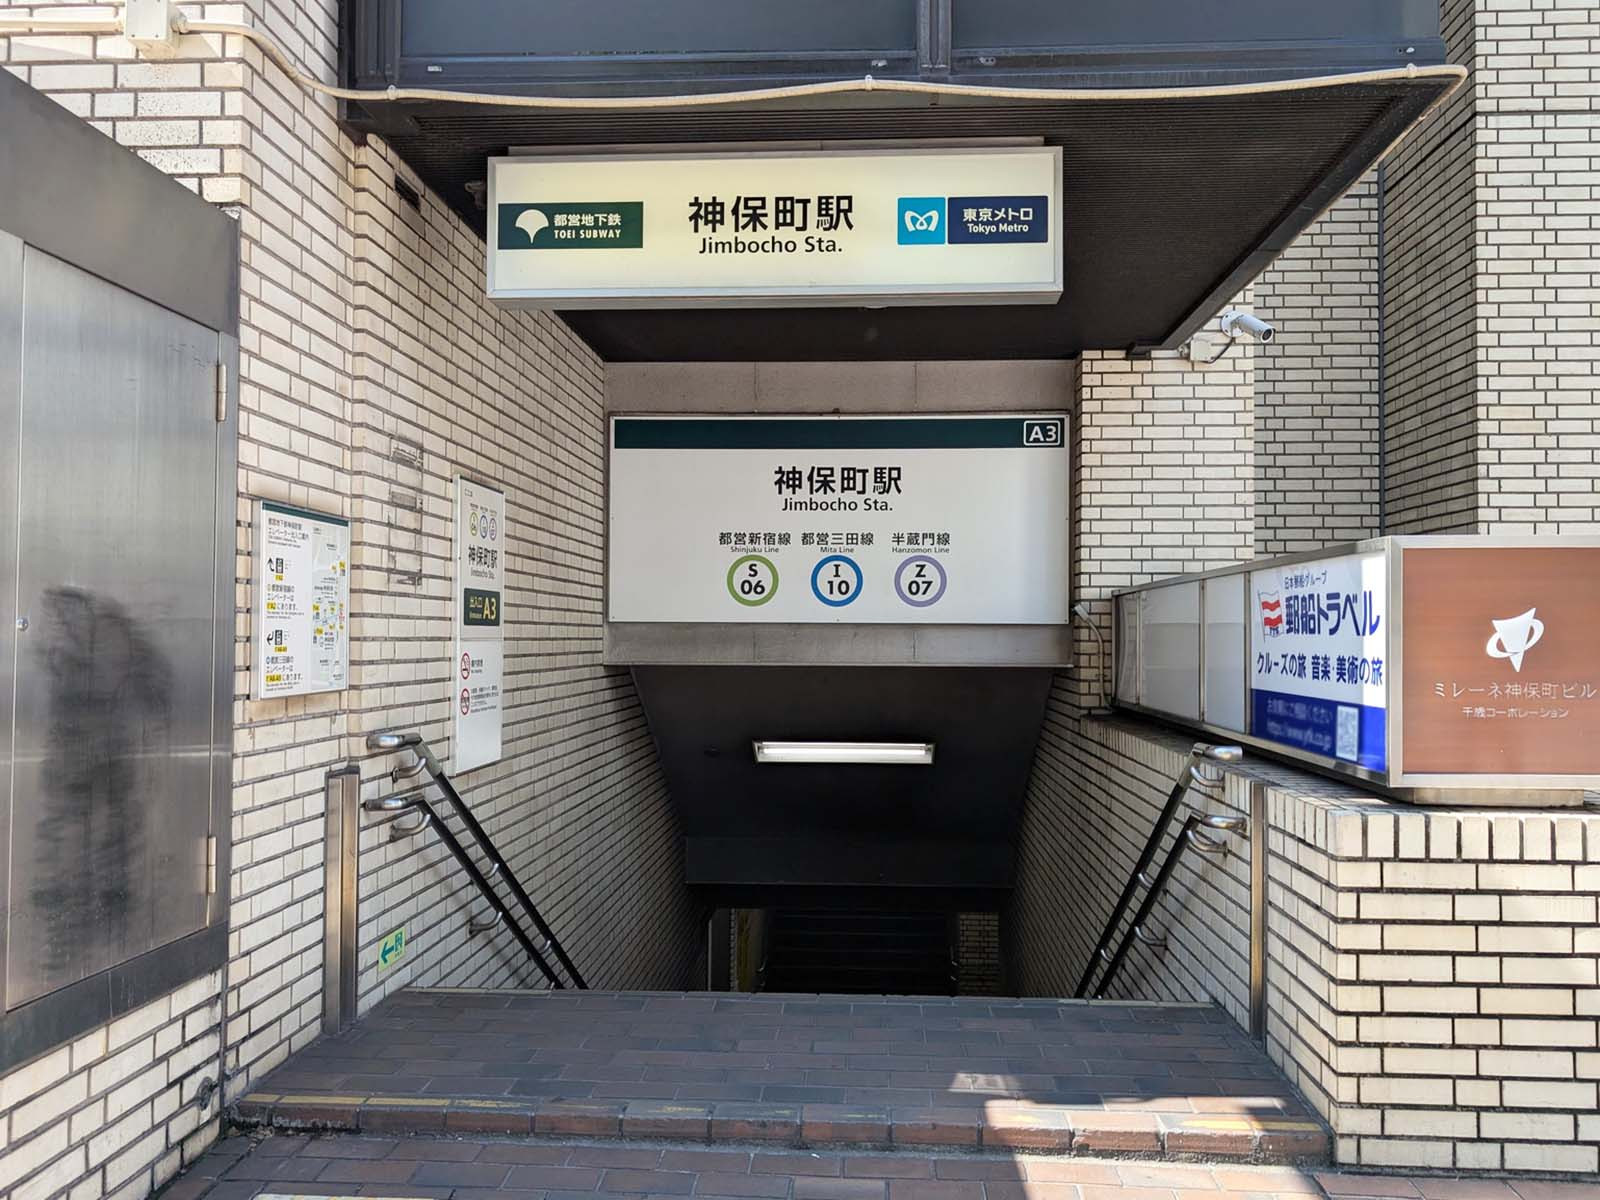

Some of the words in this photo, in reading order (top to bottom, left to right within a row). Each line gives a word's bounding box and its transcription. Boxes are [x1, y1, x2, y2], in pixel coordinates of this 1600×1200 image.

[554, 214, 621, 226] 都営地下鉄
[689, 196, 853, 233] 神保町駅
[963, 208, 1032, 221] 東京メトロ
[554, 230, 575, 238] TOEI
[580, 230, 621, 238] SUBWAY
[967, 223, 997, 235] Tokyo
[999, 223, 1028, 232] Metro
[699, 236, 796, 253] Jimbocho
[805, 236, 842, 252] Sta.
[1029, 426, 1057, 442] A3
[774, 466, 901, 495] 神保町駅
[782, 498, 857, 511] Jimbocho
[864, 498, 892, 511] Sta.
[719, 532, 791, 546] 都営新宿線
[801, 532, 874, 546] 都営三田線
[891, 532, 951, 546] 半蔵門線
[468, 545, 498, 569] 神保町駅
[730, 546, 763, 554] Shinjuku
[749, 564, 758, 577] S
[833, 564, 840, 577] I
[915, 564, 926, 577] Z
[740, 579, 765, 595] 06
[827, 580, 850, 596] 10
[907, 580, 933, 596] 07
[482, 597, 497, 620] A3
[1285, 590, 1380, 636] 郵船トラベル
[1257, 652, 1306, 680] クルーズの旅
[1311, 653, 1383, 686] 音楽・美術の旅
[1434, 682, 1597, 699] ミレーネ神保町ビル
[1462, 706, 1569, 719] 千歳コーポレーション
